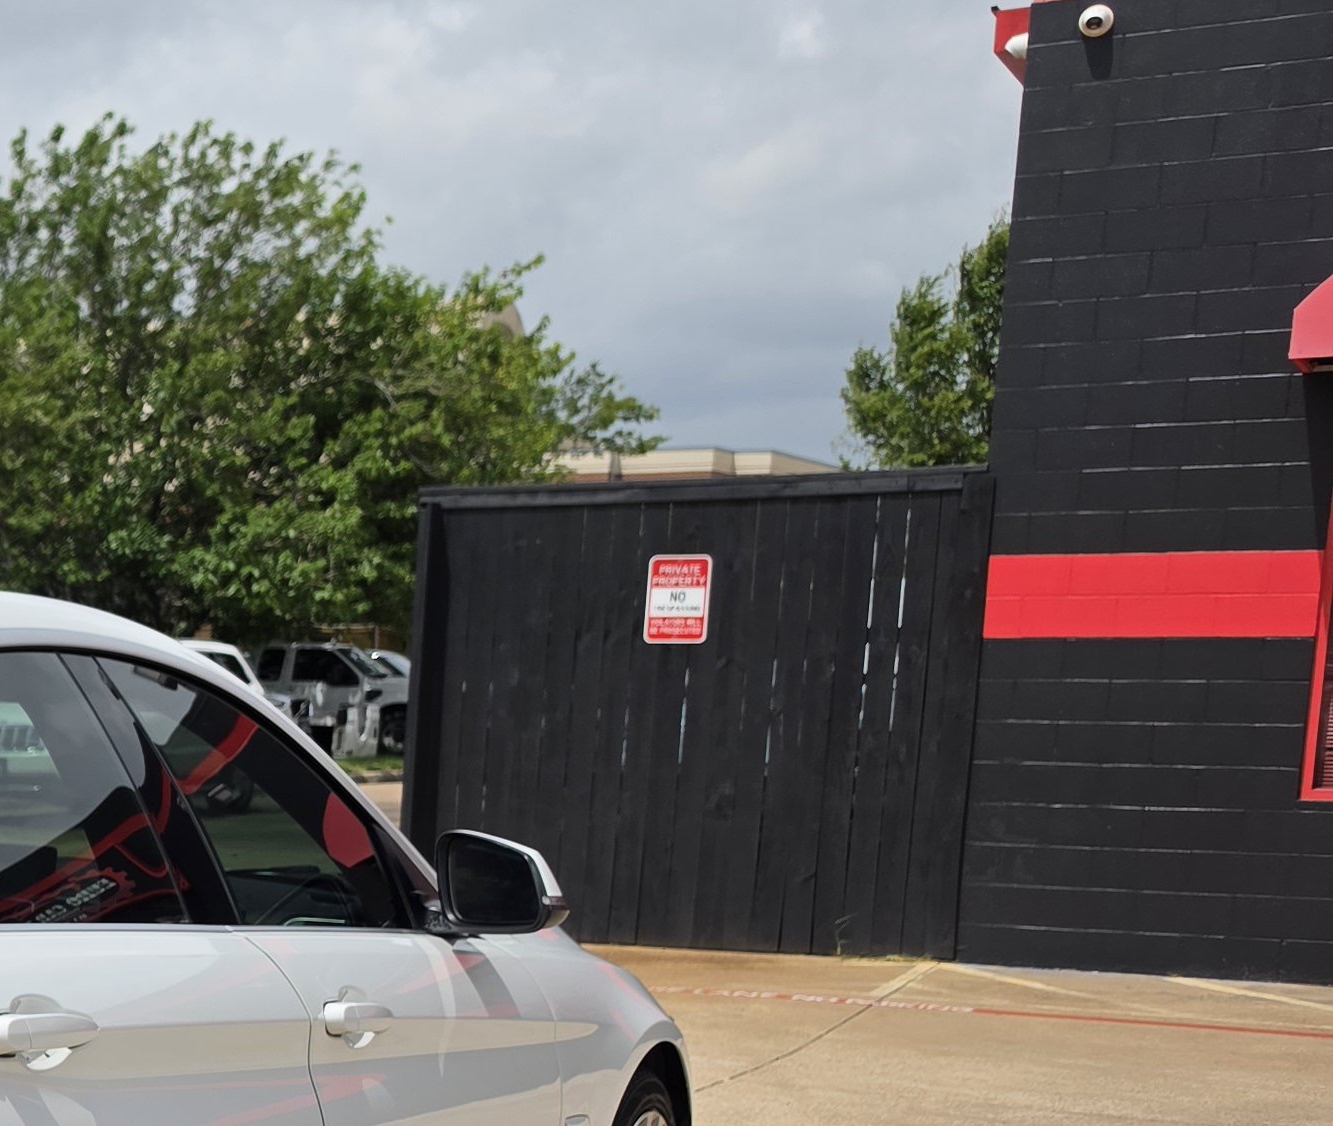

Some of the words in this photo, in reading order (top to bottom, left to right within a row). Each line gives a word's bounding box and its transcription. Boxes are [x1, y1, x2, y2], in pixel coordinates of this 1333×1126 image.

[659, 563, 701, 575] PRIVATE
[653, 575, 706, 587] PROPERTY
[669, 591, 686, 603] NO
